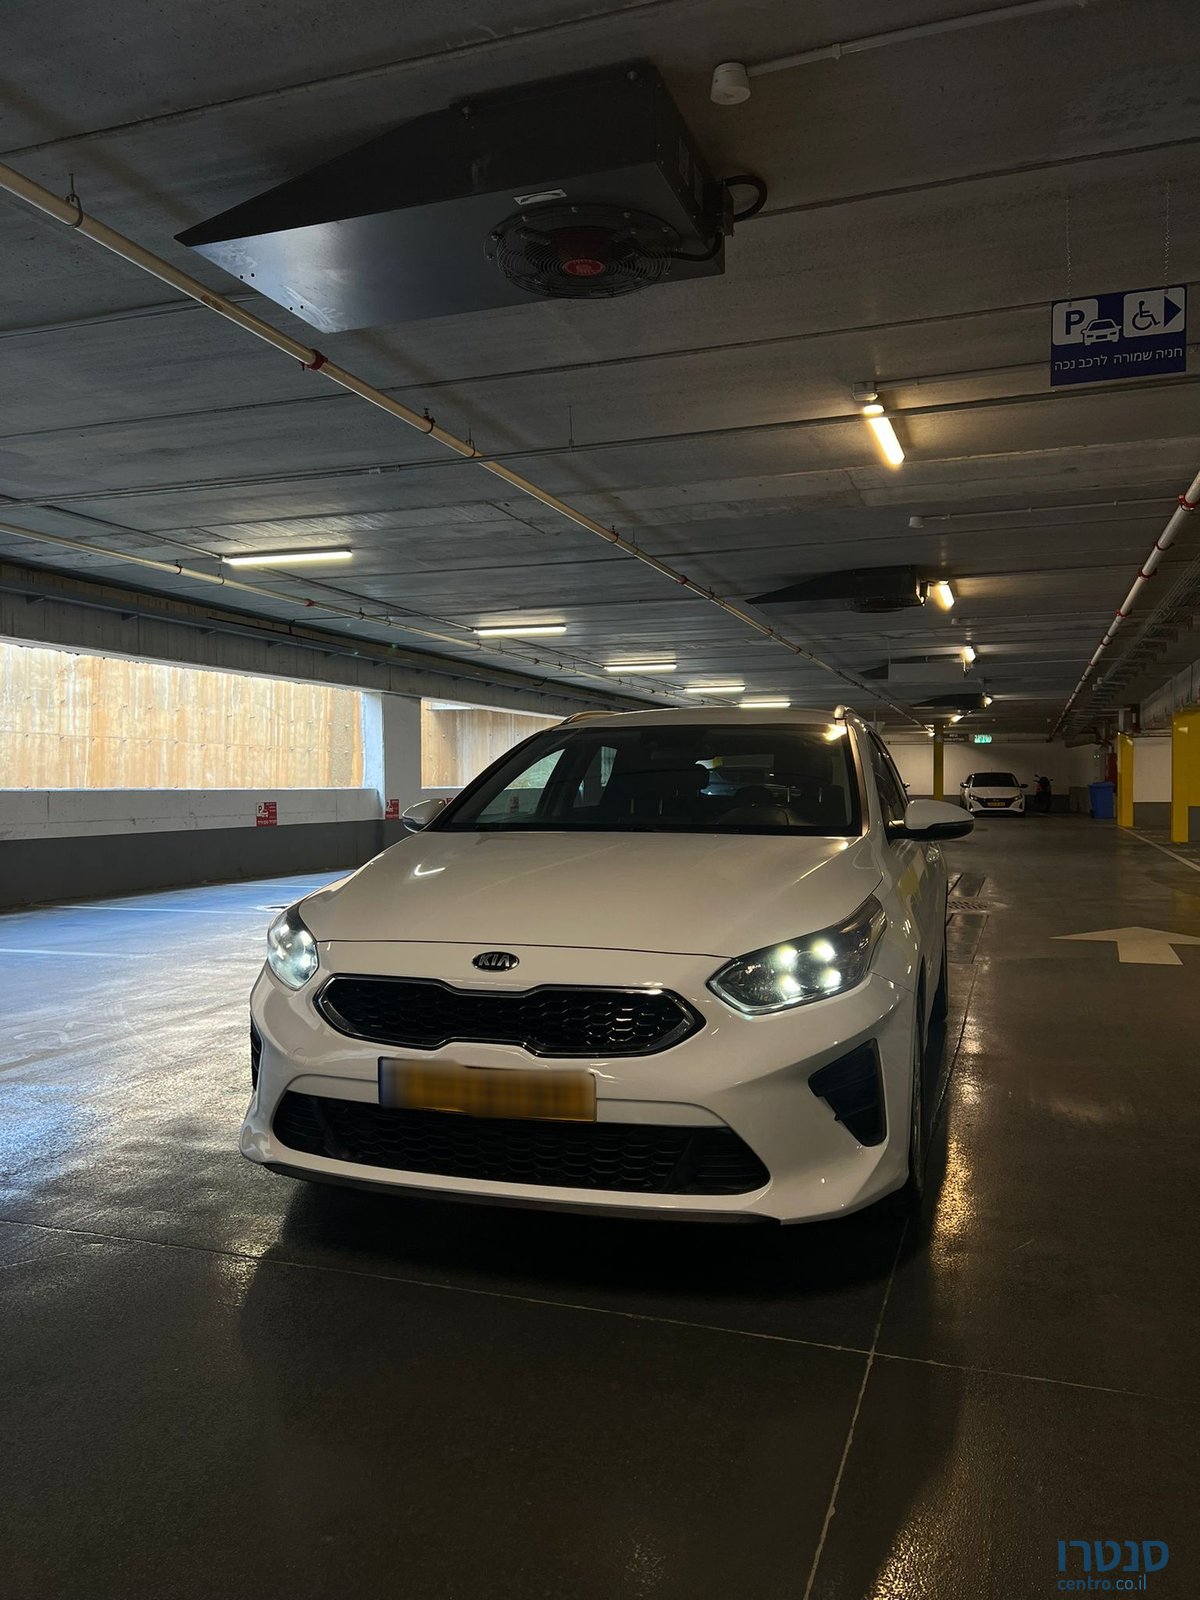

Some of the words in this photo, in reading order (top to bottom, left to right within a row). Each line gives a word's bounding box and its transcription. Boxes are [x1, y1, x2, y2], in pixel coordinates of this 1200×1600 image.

[1065, 309, 1085, 336] P
[1113, 350, 1152, 364] שמורה
[1155, 347, 1183, 360] חניה
[1054, 360, 1075, 371] נכה
[1078, 354, 1108, 369] לרכב
[478, 953, 510, 967] KIA
